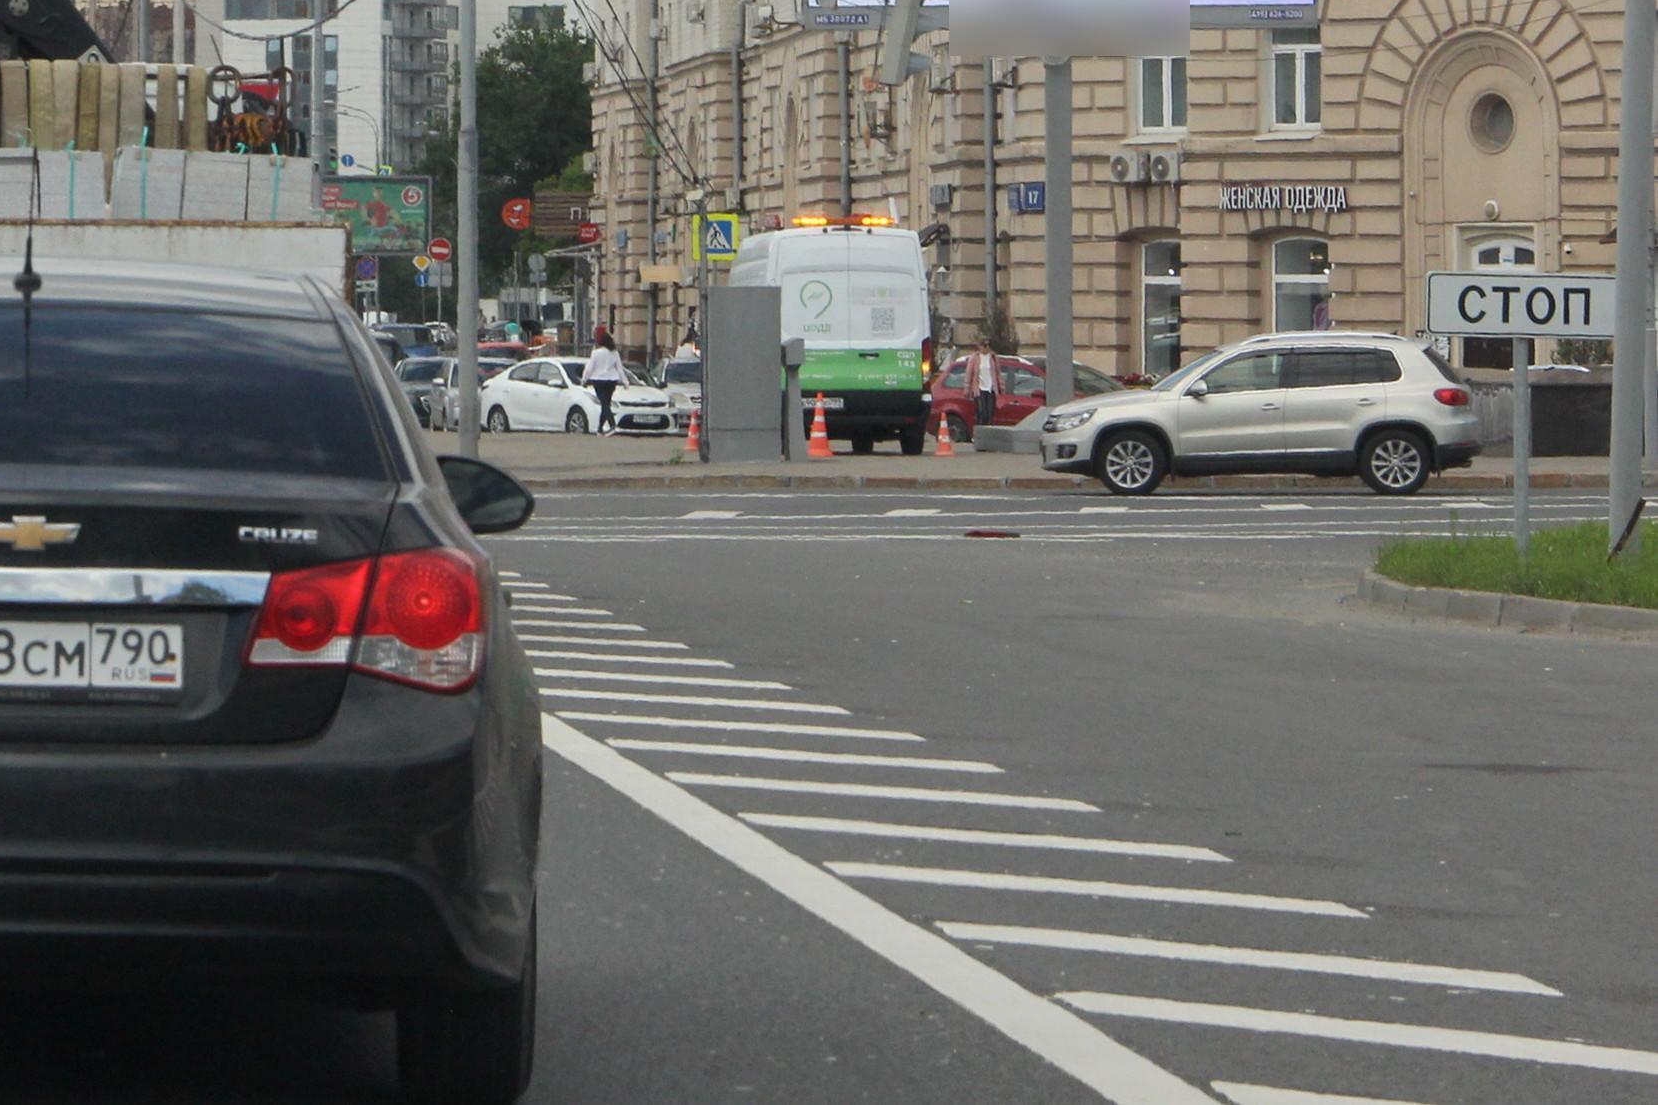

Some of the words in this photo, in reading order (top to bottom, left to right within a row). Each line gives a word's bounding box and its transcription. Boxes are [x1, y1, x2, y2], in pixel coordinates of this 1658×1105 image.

[1028, 190, 1039, 205] 17
[1219, 186, 1280, 210] ЖЕНСКАЯ
[1285, 186, 1346, 213] ОДЕЖДА
[1458, 285, 1590, 326] СТОП
[238, 525, 319, 545] CRUZE
[95, 627, 171, 666] 790
